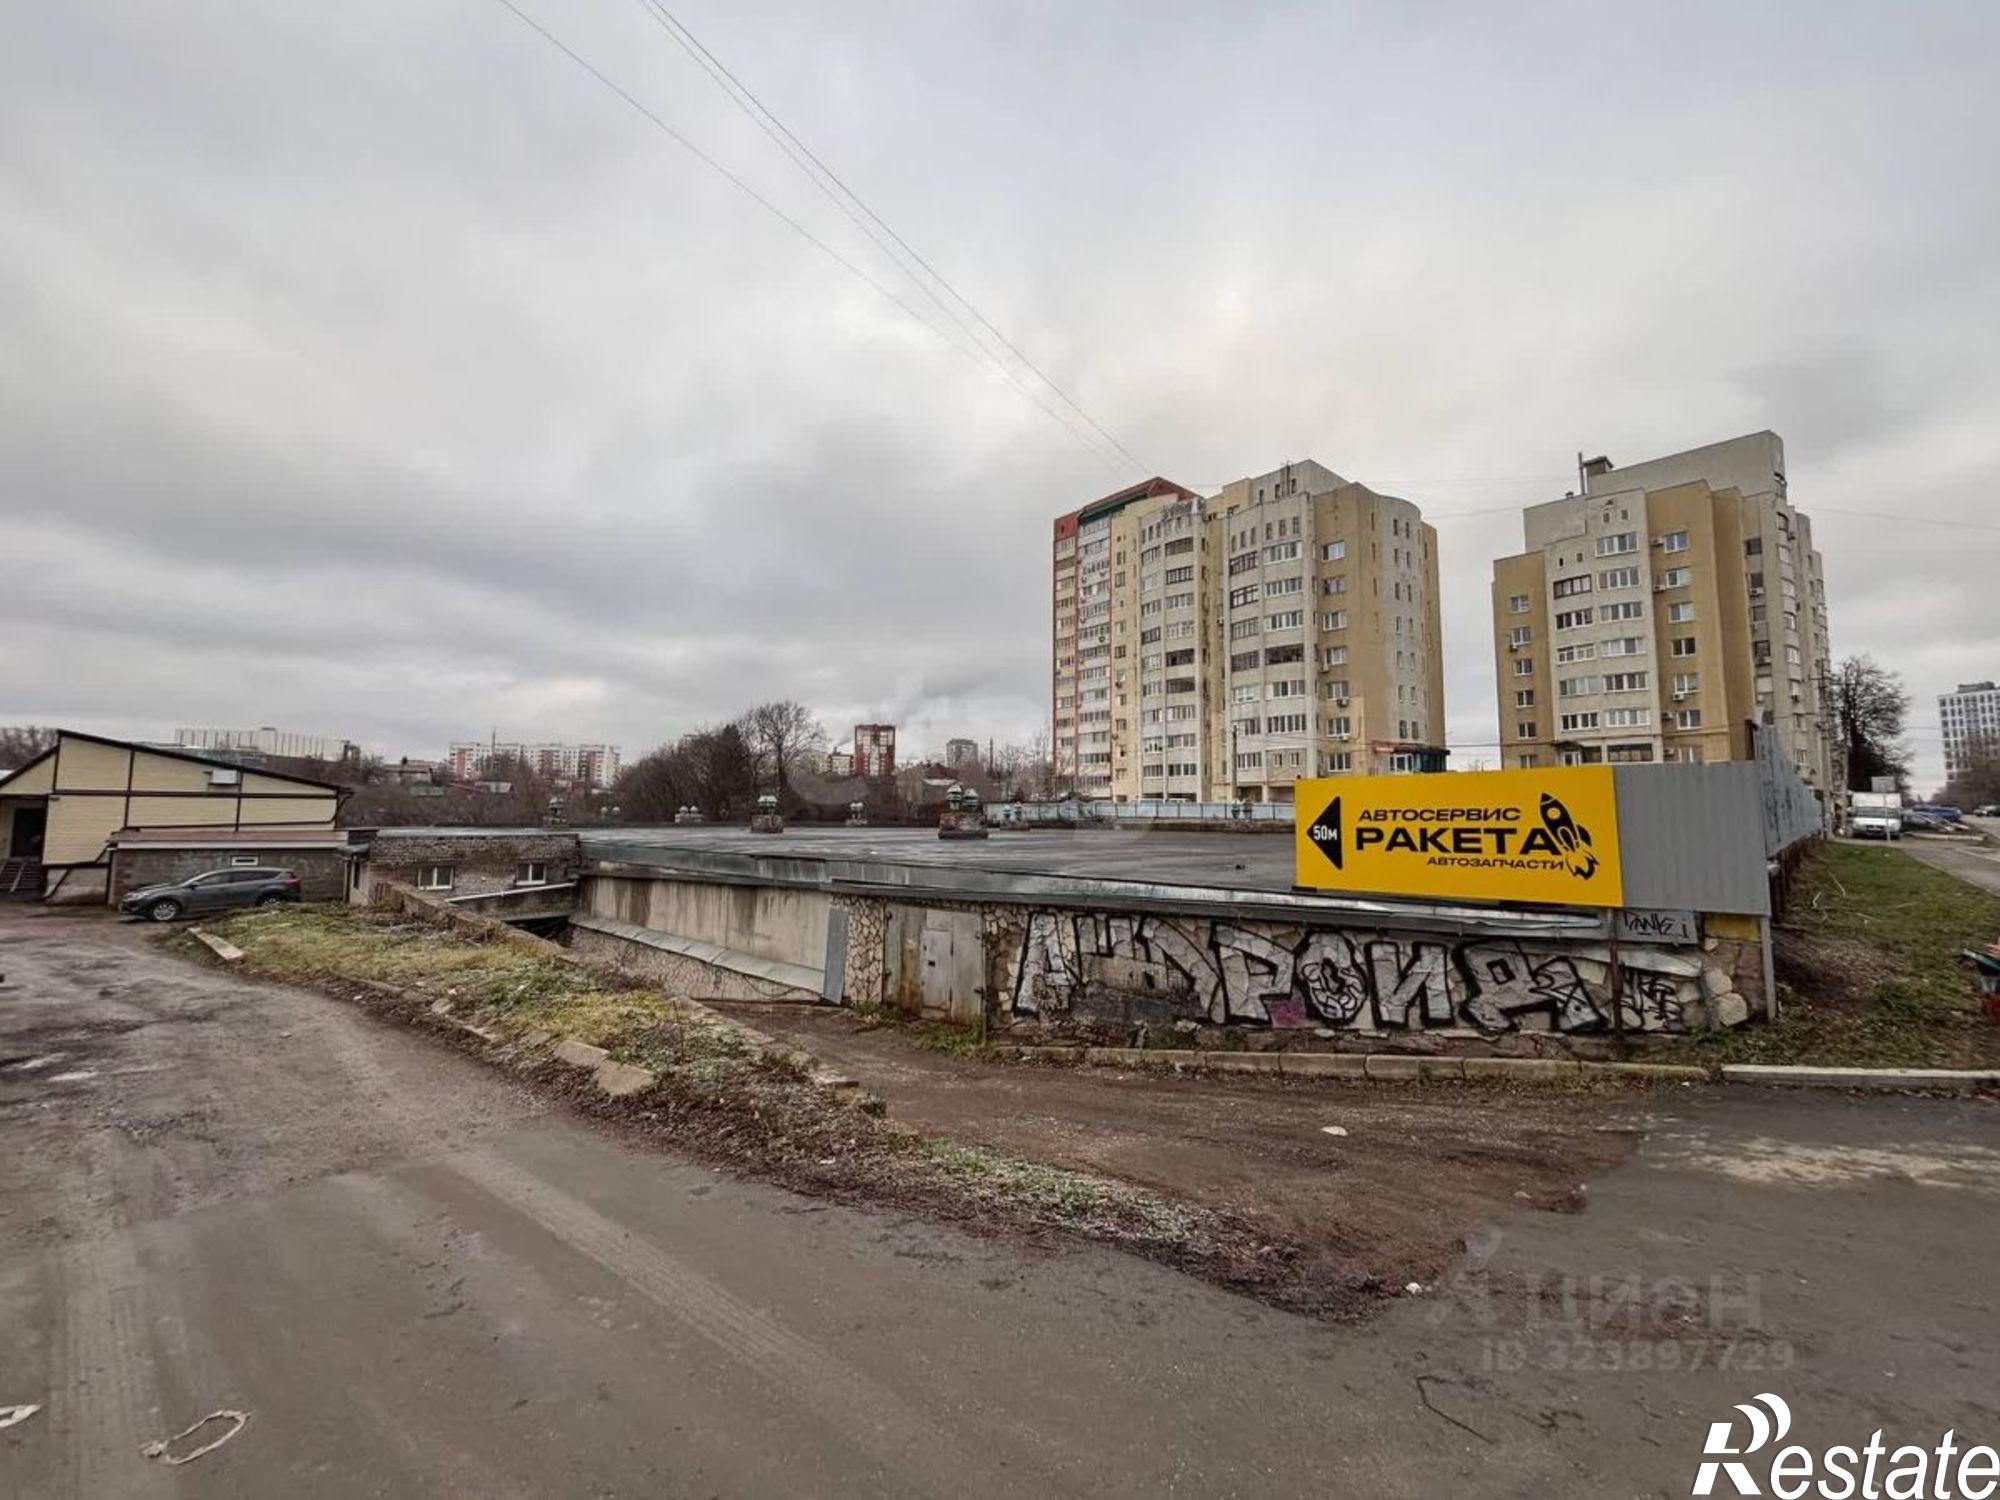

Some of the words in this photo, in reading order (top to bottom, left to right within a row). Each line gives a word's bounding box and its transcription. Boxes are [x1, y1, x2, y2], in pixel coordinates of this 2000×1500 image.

[1358, 807, 1521, 822] АВТОСЕРВИС
[1355, 827, 1562, 857] РАКЕТА
[1427, 857, 1564, 871] АВТОЗАПЧАСТИ
